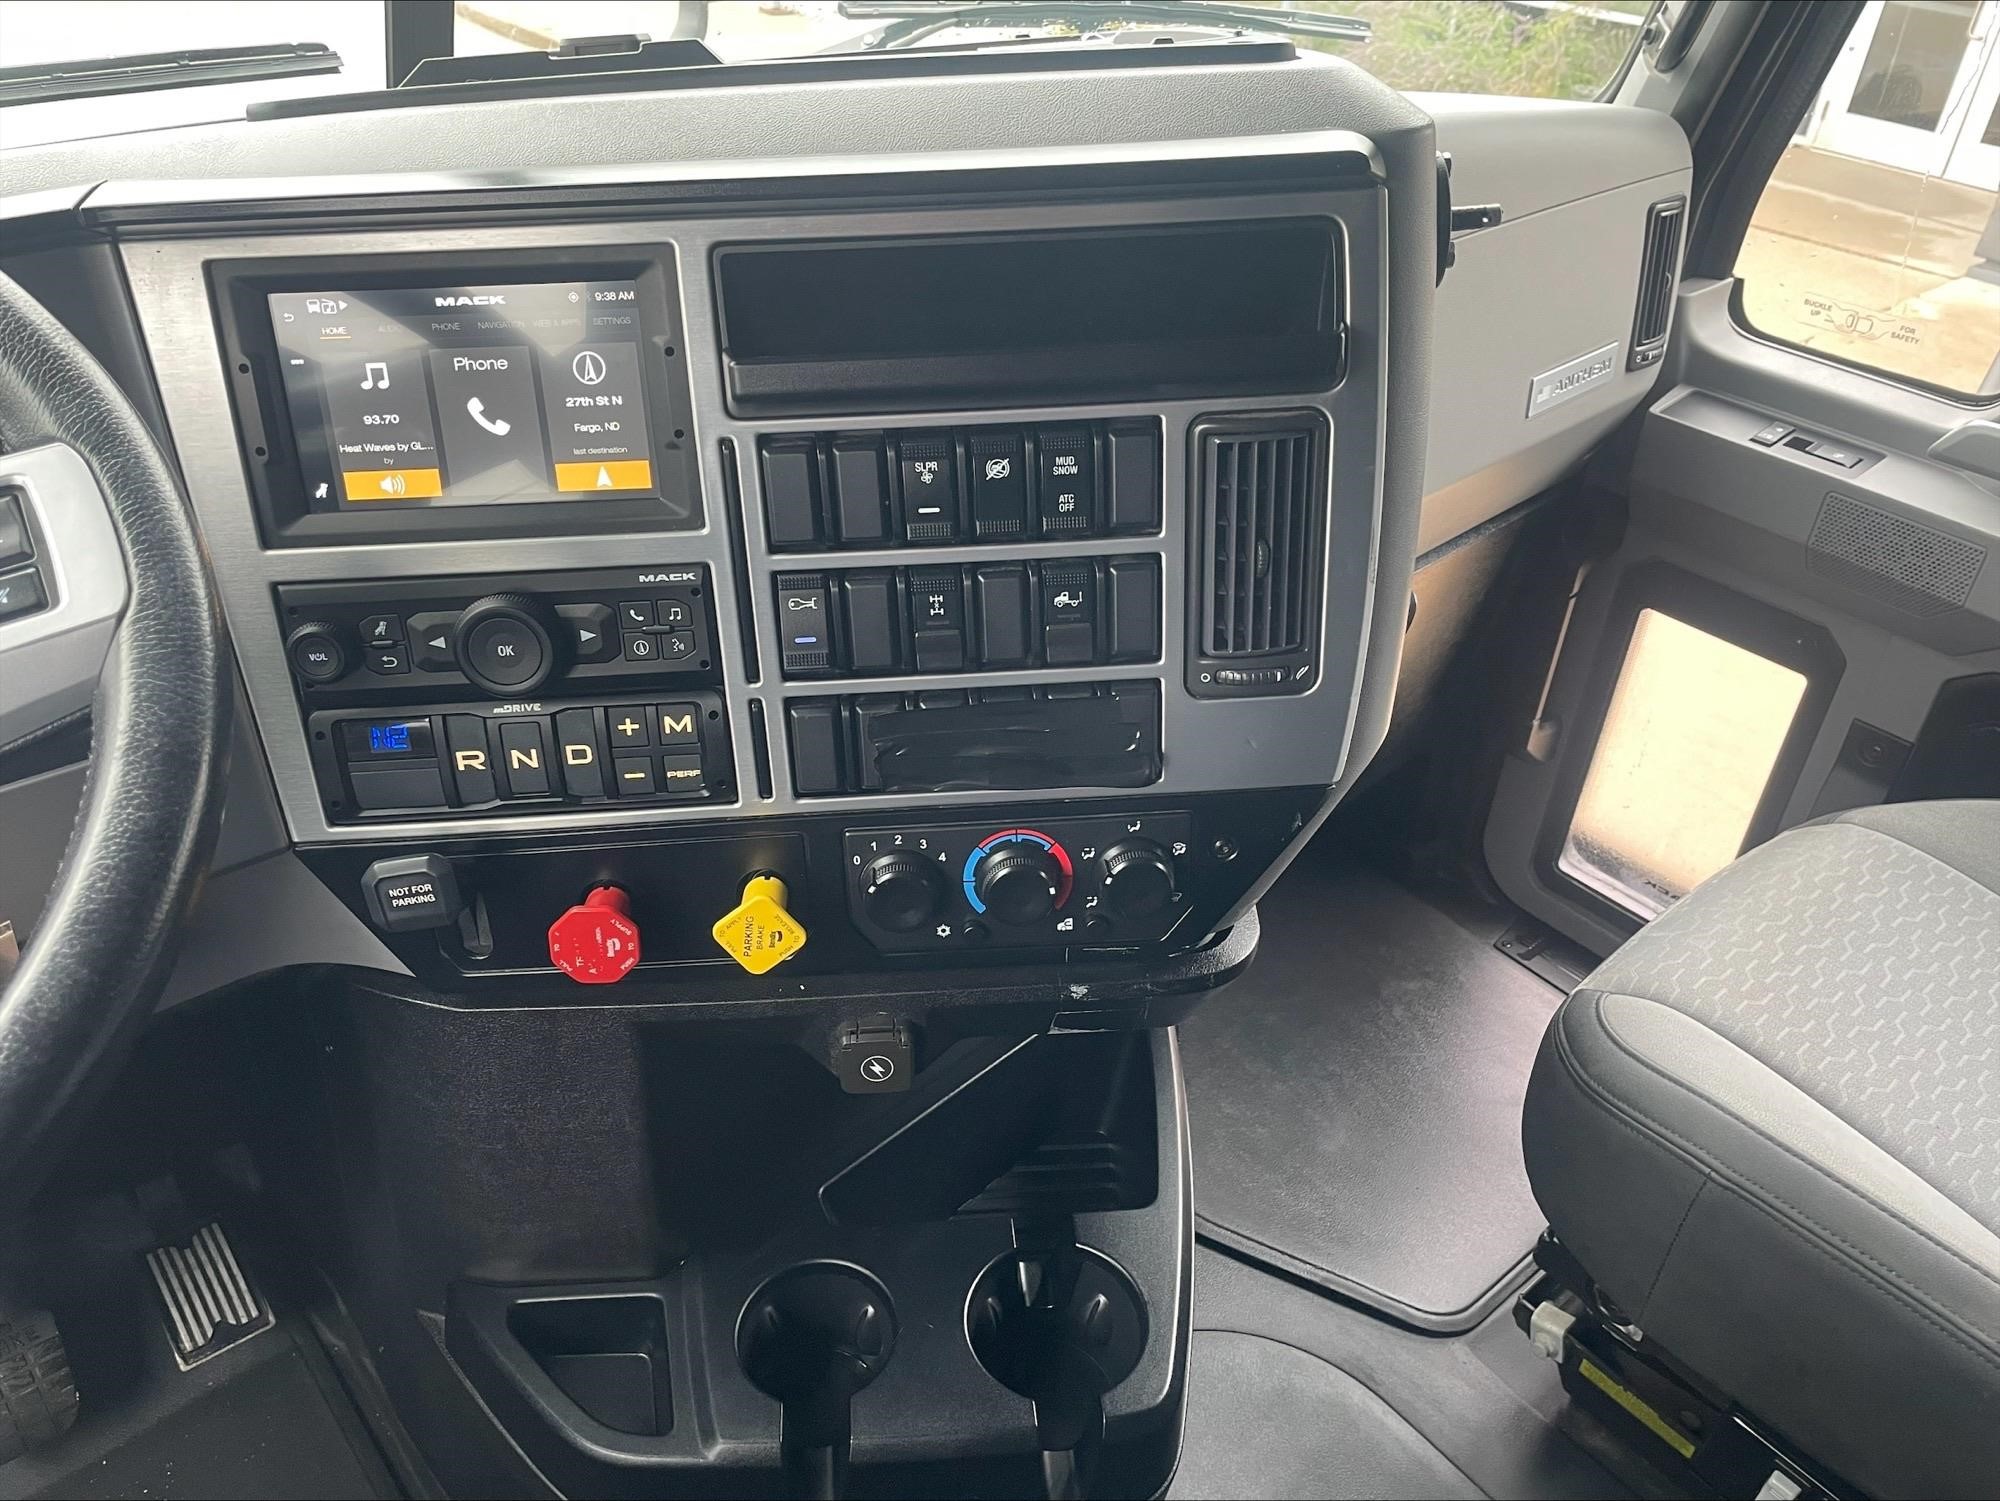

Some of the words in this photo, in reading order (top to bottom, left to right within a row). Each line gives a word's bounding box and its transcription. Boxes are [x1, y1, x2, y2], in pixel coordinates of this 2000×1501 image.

[434, 295, 506, 307] MACK
[594, 291, 616, 301] 9:38
[618, 291, 635, 300] AM
[1804, 299, 1832, 312] BUCKLE
[431, 322, 461, 331] PHONE
[592, 316, 632, 326] SETTINGS
[321, 326, 348, 335] HOME
[1900, 325, 1916, 334] FOR
[1890, 332, 1919, 344] SAFETY
[453, 357, 508, 371] Phone
[565, 396, 594, 407] 27th
[595, 395, 610, 406] St
[611, 395, 622, 405] N
[362, 414, 399, 425] 93.70
[573, 423, 604, 434] Fargo,
[604, 421, 620, 431] ND
[339, 444, 362, 453] Heat
[362, 443, 396, 452] Waves
[397, 442, 409, 452] by
[573, 447, 586, 455] last
[587, 447, 628, 455] destination
[383, 457, 394, 465] by
[1055, 455, 1075, 466] MUD
[915, 461, 938, 473] SLPR
[1052, 464, 1079, 476] SNOW
[1058, 493, 1075, 504] ATC
[1058, 502, 1075, 513] OFF
[638, 572, 697, 583] MACK
[497, 645, 515, 656] OK
[308, 652, 329, 661] VOL
[493, 703, 541, 713] mDRIVE
[663, 714, 693, 734] M
[510, 748, 540, 769] N
[565, 744, 593, 765] D
[455, 750, 487, 771] R
[666, 769, 701, 778] PERF
[894, 834, 903, 845] 2
[919, 839, 927, 849] 3
[870, 841, 877, 851] 1
[853, 855, 861, 865] 0
[938, 852, 947, 862] 4
[388, 887, 409, 897] NOT
[411, 883, 433, 894] FOR
[392, 894, 436, 908] PARKING
[743, 916, 755, 957] PARKING
[755, 925, 765, 951] BRAKE
